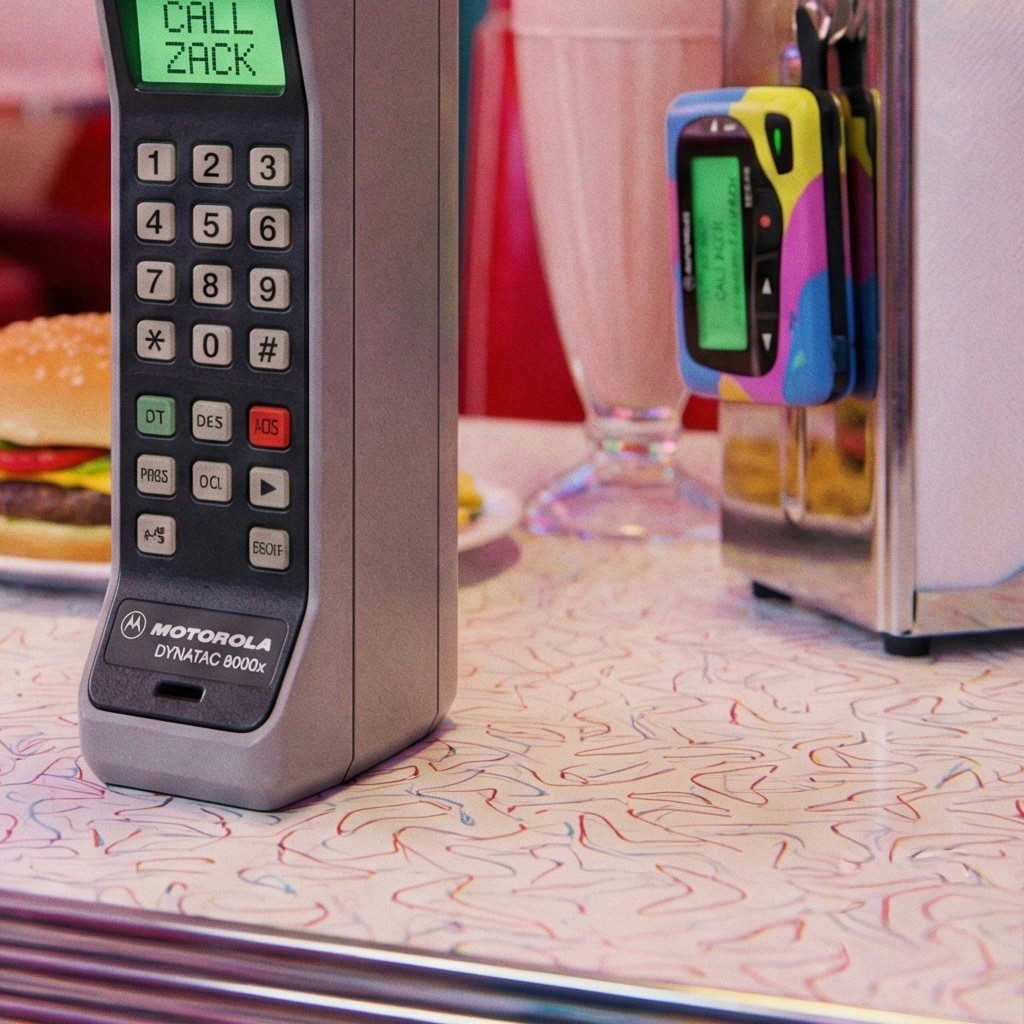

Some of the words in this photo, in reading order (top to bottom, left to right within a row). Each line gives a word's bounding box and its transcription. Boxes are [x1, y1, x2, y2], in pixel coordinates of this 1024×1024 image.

[163, 0, 254, 35] CALL
[165, 41, 256, 76] ZACK
[148, 150, 159, 175] 1
[203, 152, 220, 177] 2
[260, 154, 276, 180] 3
[145, 209, 163, 234] 4
[203, 212, 219, 238] 5
[259, 215, 276, 241] 6
[146, 269, 163, 294] 7
[202, 272, 219, 298] 8
[260, 276, 276, 302] 9
[202, 332, 219, 358] 0
[196, 414, 223, 430] DES
[150, 622, 272, 652] MOTOROLA
[154, 643, 222, 667] DYNATAC
